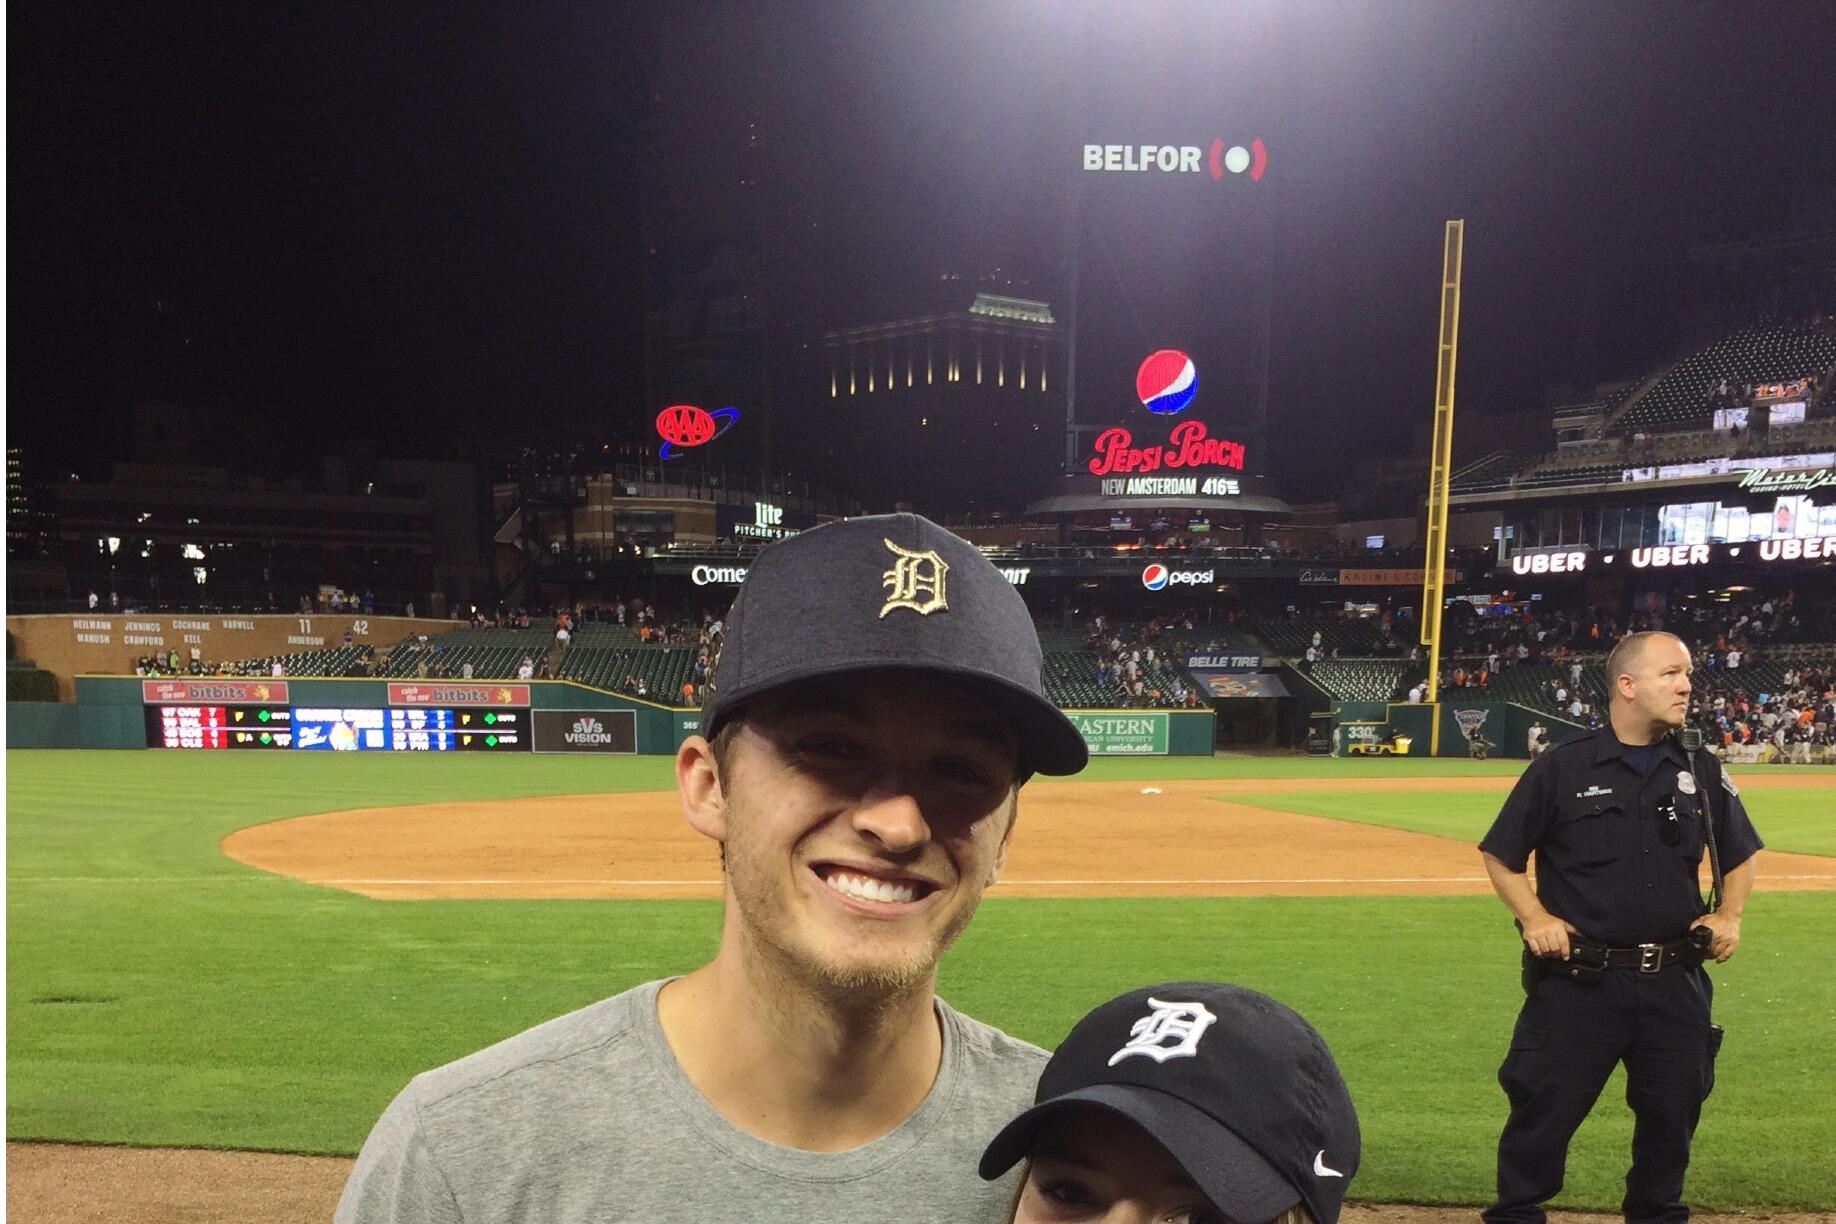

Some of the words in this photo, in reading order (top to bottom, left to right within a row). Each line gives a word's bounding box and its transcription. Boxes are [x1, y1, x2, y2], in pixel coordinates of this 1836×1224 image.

[1083, 144, 1201, 172] BELFOR
[661, 407, 713, 444] AAA
[1101, 479, 1125, 495] NEW
[1126, 478, 1197, 495] AMSTERDAM
[1201, 478, 1226, 495] 416
[755, 502, 783, 528] Lite
[735, 525, 782, 538] PITCHER'S
[1512, 552, 1585, 574] UBER
[1632, 545, 1710, 567] UBER
[1760, 536, 1836, 560] UBER
[878, 538, 950, 620] D
[1169, 569, 1214, 586] pepsi
[125, 622, 160, 632] JENNINGS
[172, 620, 210, 631] COCHRANE
[299, 619, 311, 634] 11
[353, 620, 369, 635] 42
[124, 635, 164, 646] CRAWFORD
[184, 634, 201, 643] KELL
[288, 635, 324, 645] ANDERSON
[1188, 656, 1227, 668] BELLE
[1230, 656, 1260, 668] TIRE
[189, 686, 246, 699] bitbits
[433, 689, 488, 702] bitbits
[565, 733, 611, 743] VISION
[1108, 997, 1217, 1067] D
